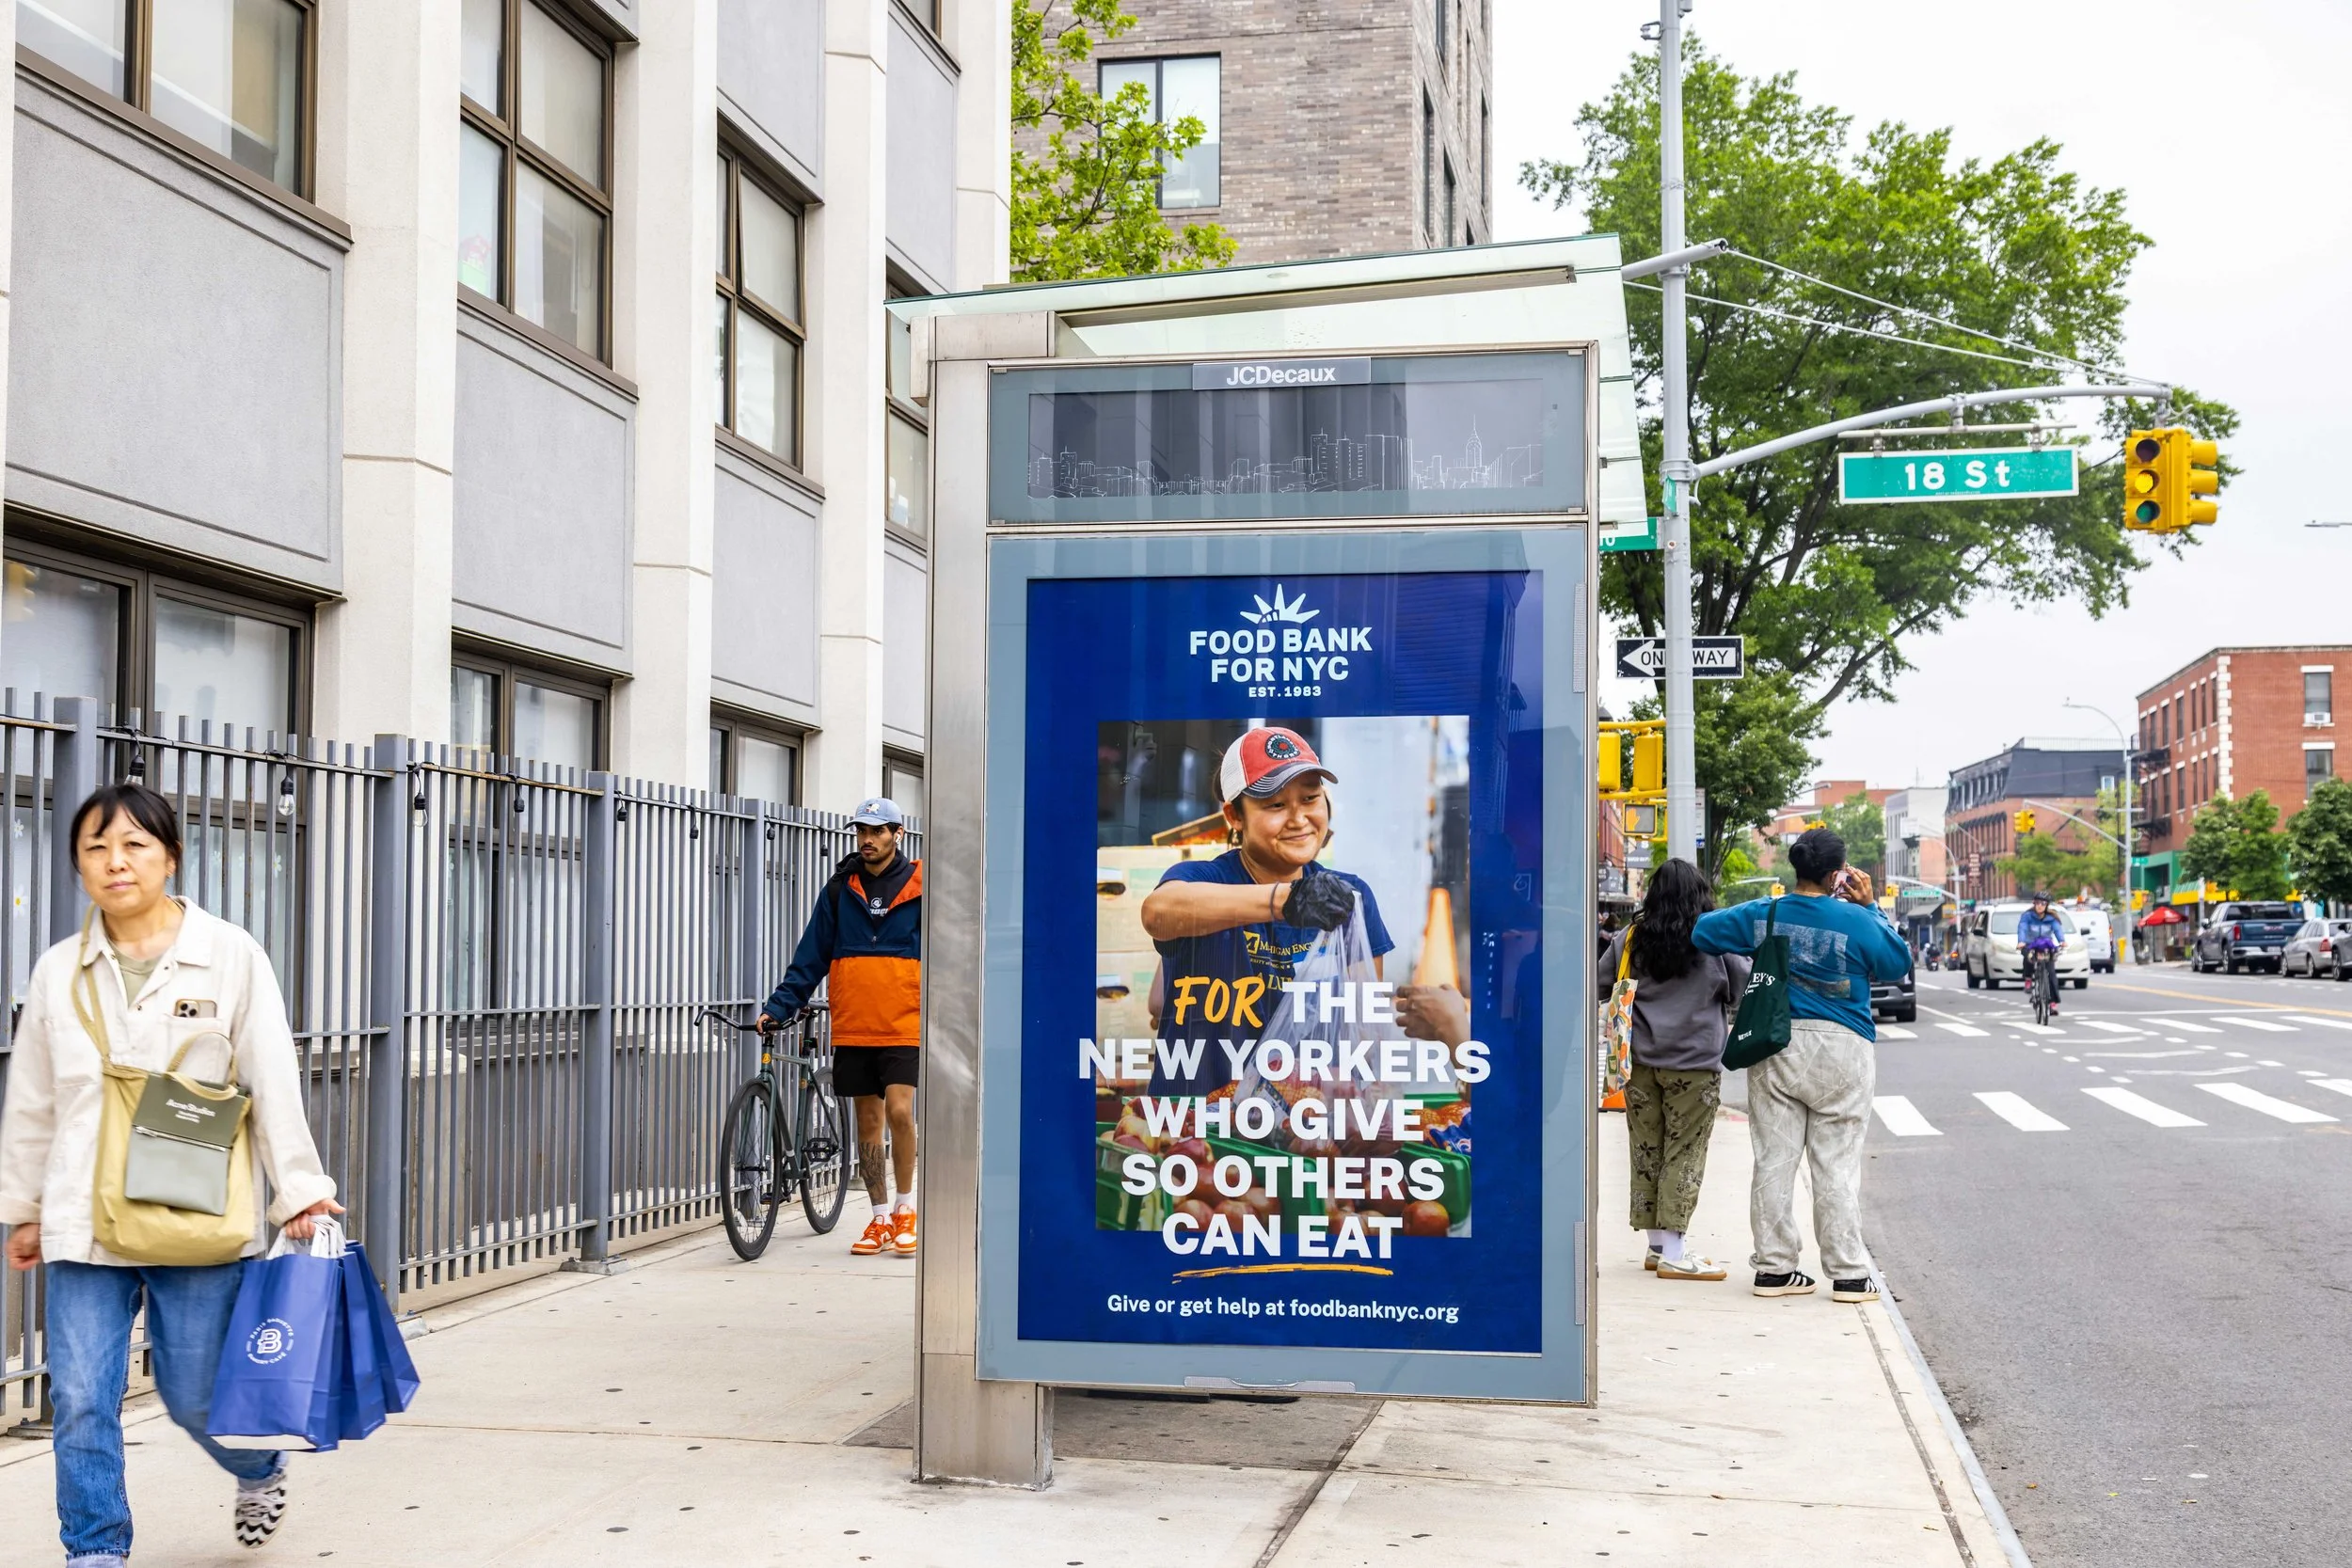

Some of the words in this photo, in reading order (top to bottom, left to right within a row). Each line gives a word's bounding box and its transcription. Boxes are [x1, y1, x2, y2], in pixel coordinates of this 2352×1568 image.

[1226, 364, 1337, 387] JCDecaux
[1904, 462, 1946, 490] 18
[1964, 459, 2010, 489] St
[1189, 630, 1278, 655] FOOD
[1281, 626, 1373, 653] BANK
[1210, 658, 1278, 683] FOR
[1282, 655, 1349, 681] NYC
[1641, 650, 1666, 666] ON
[1692, 650, 1728, 665] WAY
[1753, 972, 1776, 987] EY'S
[1173, 976, 1264, 1028] FOR
[1283, 982, 1393, 1023] THE
[1078, 1038, 1206, 1080] NEW
[1218, 1039, 1491, 1084] YORKERS
[1140, 1096, 1276, 1139] WHO
[1290, 1099, 1424, 1141] GIVE
[1121, 1154, 1198, 1196] SO
[1213, 1156, 1445, 1200] OTHERS
[1162, 1213, 1280, 1257] CAN
[1297, 1215, 1404, 1259] EAT
[1106, 1294, 1151, 1314] Give
[1154, 1300, 1176, 1314] or
[1179, 1297, 1213, 1319] get
[1217, 1297, 1262, 1318] help
[1265, 1301, 1286, 1316] at
[1290, 1300, 1459, 1323] foodbanknyc.org
